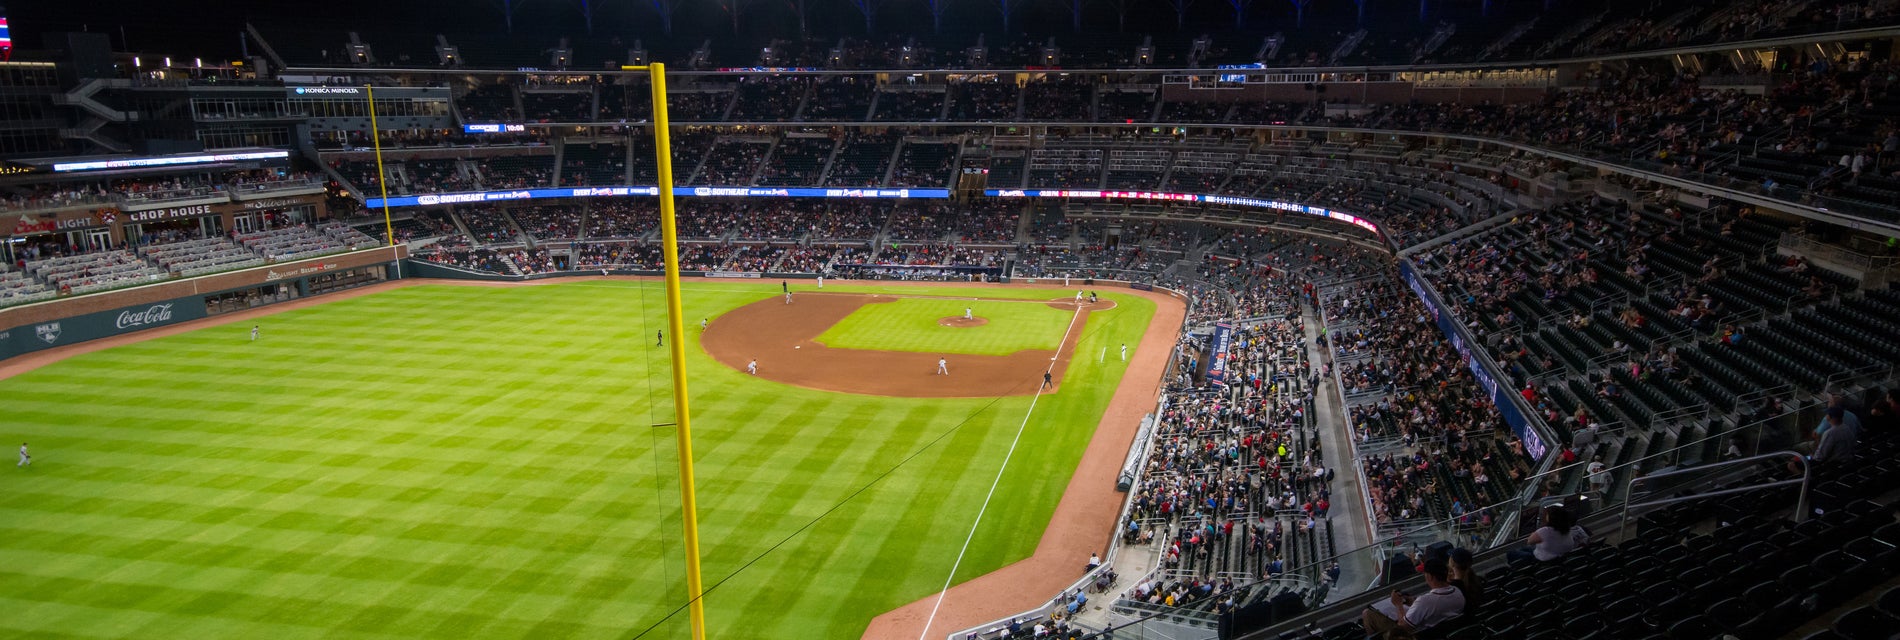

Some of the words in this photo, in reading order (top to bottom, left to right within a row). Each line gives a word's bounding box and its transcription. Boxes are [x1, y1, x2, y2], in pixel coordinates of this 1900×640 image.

[440, 193, 485, 203] SOUTHEAST
[573, 188, 591, 196] EVERY
[712, 188, 749, 196] SOUTHEAST
[130, 208, 165, 221] CHOP
[170, 205, 211, 217] HOUSE
[14, 220, 56, 234] Coors
[56, 217, 91, 230] LIGHT
[116, 303, 173, 329] Coca-Cola
